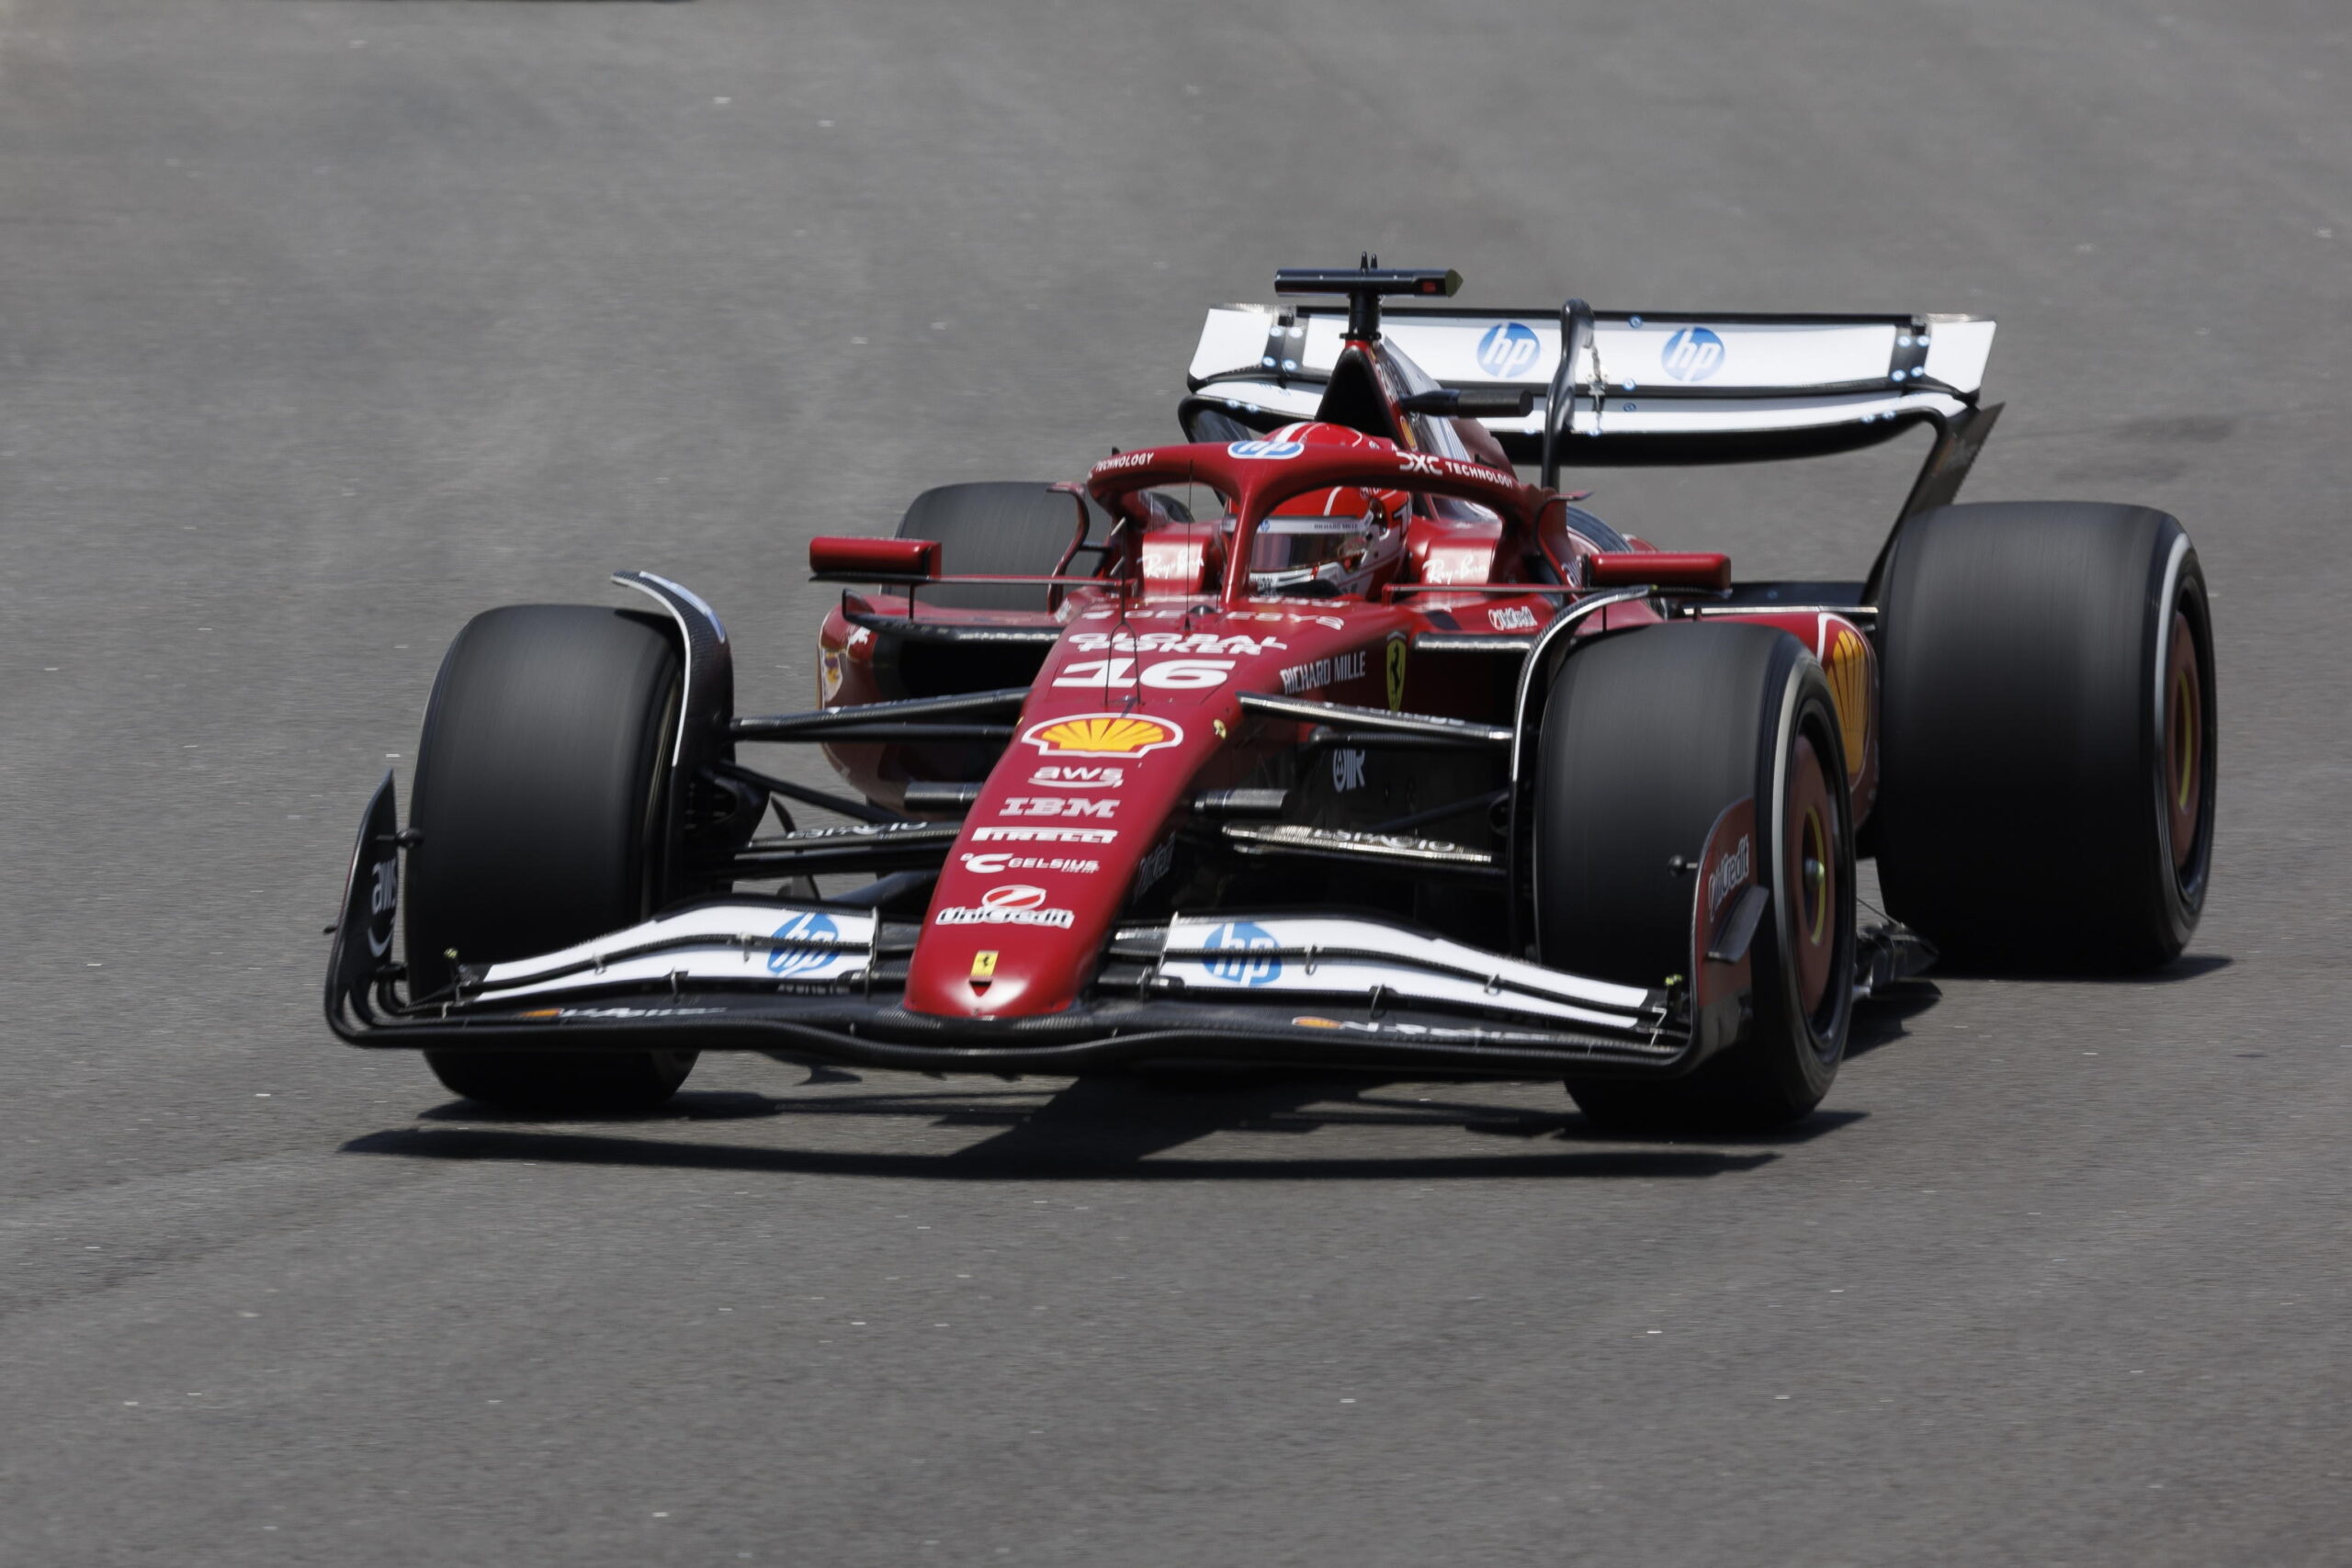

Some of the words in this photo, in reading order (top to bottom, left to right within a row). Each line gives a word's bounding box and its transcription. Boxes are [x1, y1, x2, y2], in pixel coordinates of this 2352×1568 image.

[1481, 321, 1537, 378] hp
[1666, 326, 1722, 381] hp
[1095, 452, 1155, 473] TECHNOLOGY
[1396, 450, 1443, 476] DXC
[1444, 461, 1514, 489] TECHNOLOGY
[1423, 554, 1487, 585] Ray-Ban
[1069, 633, 1287, 650] GLOBAL
[1052, 658, 1236, 689] 16
[1280, 658, 1331, 695] RICHARD
[1334, 650, 1366, 682] MILLE
[1033, 766, 1125, 783] aws
[999, 797, 1121, 818] IBM
[971, 827, 1119, 843] PIRELLI
[1008, 857, 1099, 871] CELSIUS
[770, 912, 837, 978] hp
[1213, 922, 1275, 987] hp
